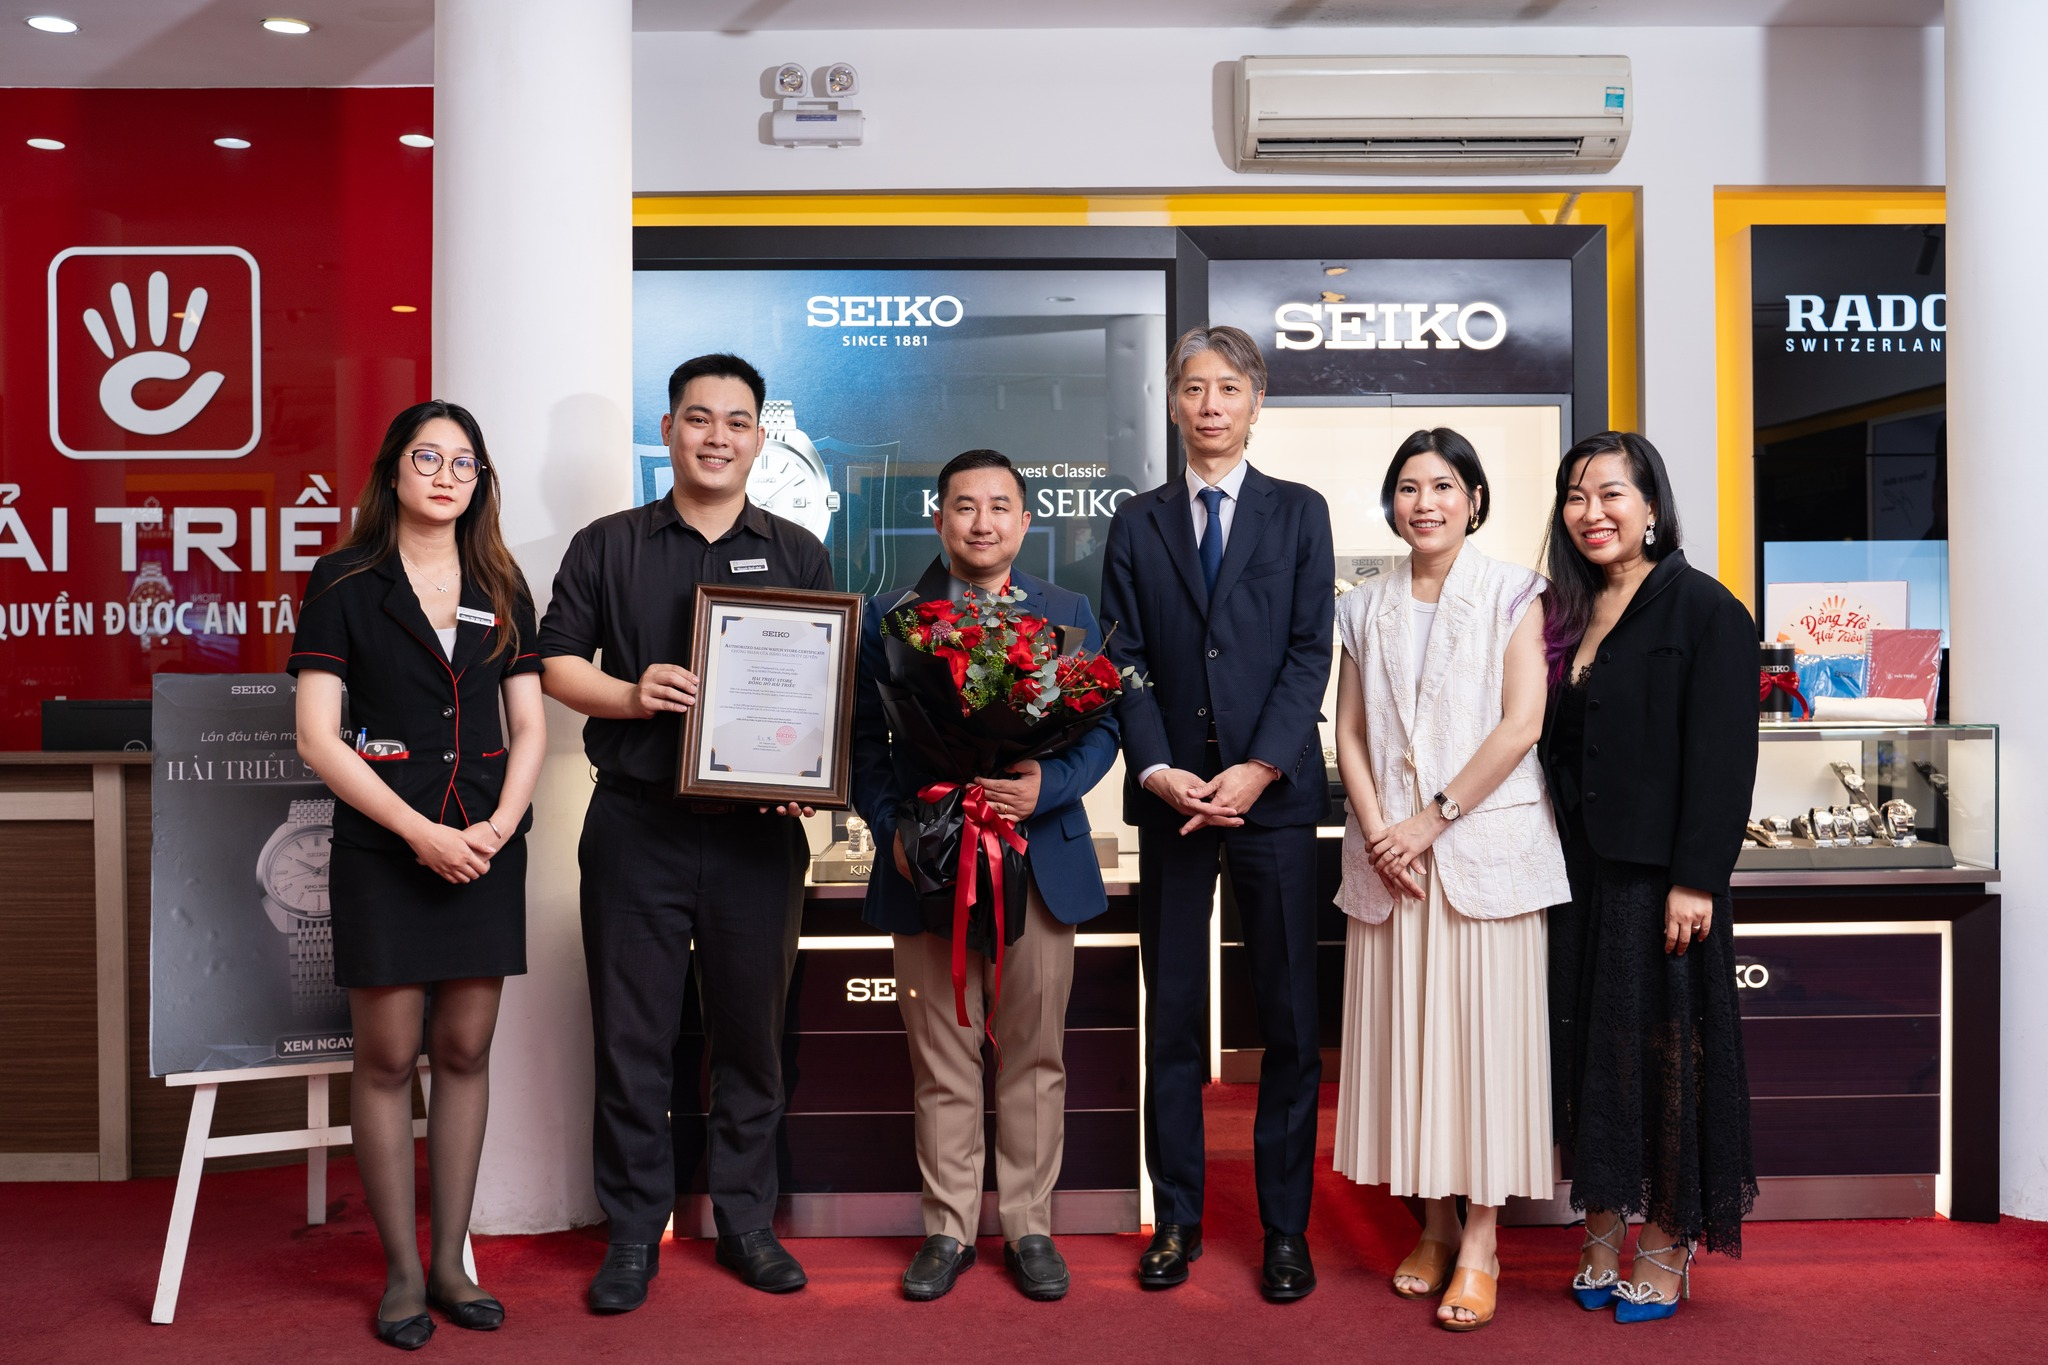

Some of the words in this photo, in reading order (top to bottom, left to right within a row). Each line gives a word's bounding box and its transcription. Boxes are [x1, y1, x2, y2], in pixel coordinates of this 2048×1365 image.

[806, 294, 964, 328] SEIKO
[1274, 301, 1507, 350] SEIKO
[842, 335, 888, 347] SINCE
[894, 335, 928, 347] 1881
[1785, 338, 1941, 352] SWITZERLAN
[1052, 462, 1106, 478] Classic
[0, 483, 68, 572] ẢI
[95, 474, 358, 572] TRIỀ
[1351, 558, 1384, 566] SEIKO
[103, 598, 194, 645] ĐƯỢC
[203, 601, 247, 635] AN
[257, 594, 302, 634] TÂ
[1800, 608, 1844, 635] Đồng
[762, 630, 790, 638] SEIKO
[231, 685, 276, 694] SEIKO
[254, 730, 277, 742] tiên
[167, 755, 213, 781] HẢI
[850, 865, 873, 876] KIN
[283, 1040, 313, 1053] XEM
[317, 1036, 354, 1050] NGAY
